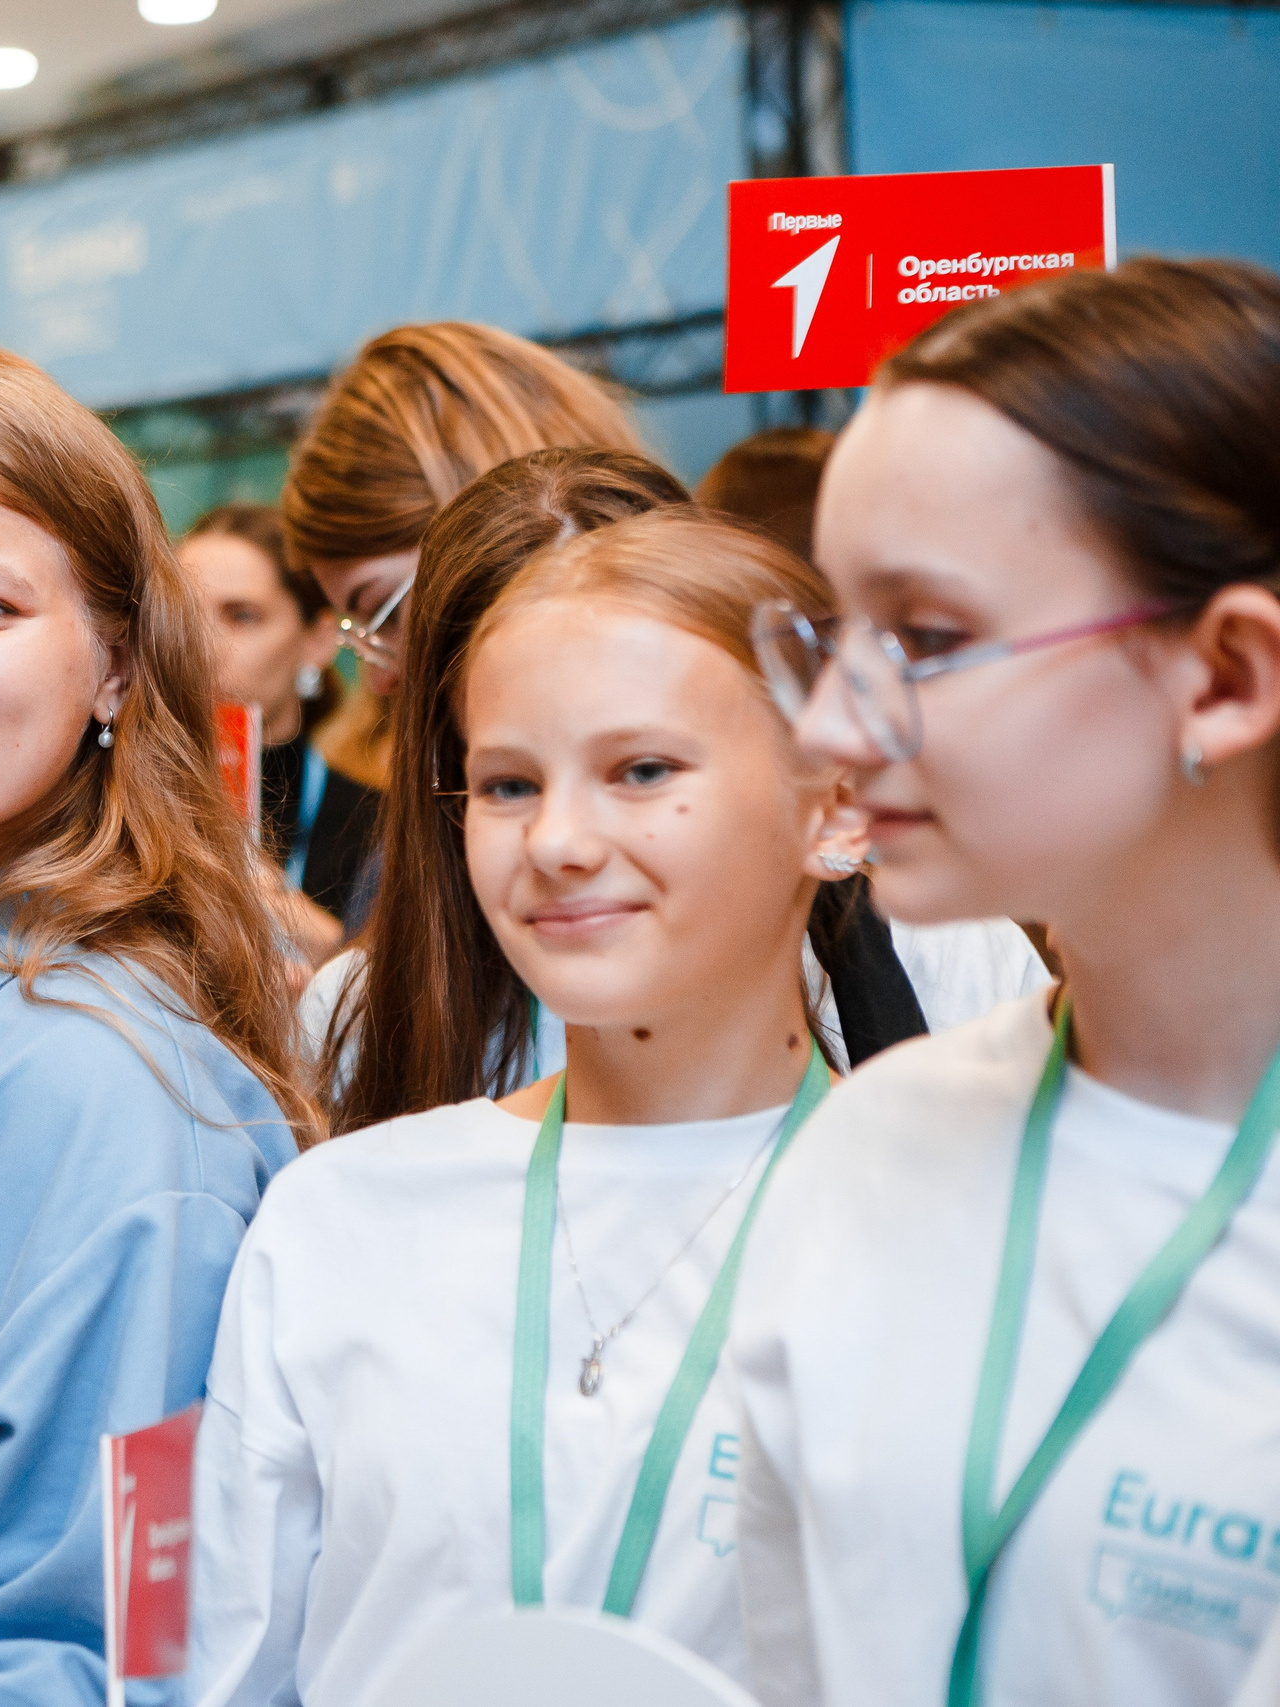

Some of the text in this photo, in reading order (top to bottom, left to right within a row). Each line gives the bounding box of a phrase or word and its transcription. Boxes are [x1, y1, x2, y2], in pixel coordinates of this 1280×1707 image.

[768, 211, 842, 235] Первые
[898, 251, 1074, 280] Оренбургская
[897, 282, 1001, 304] область
